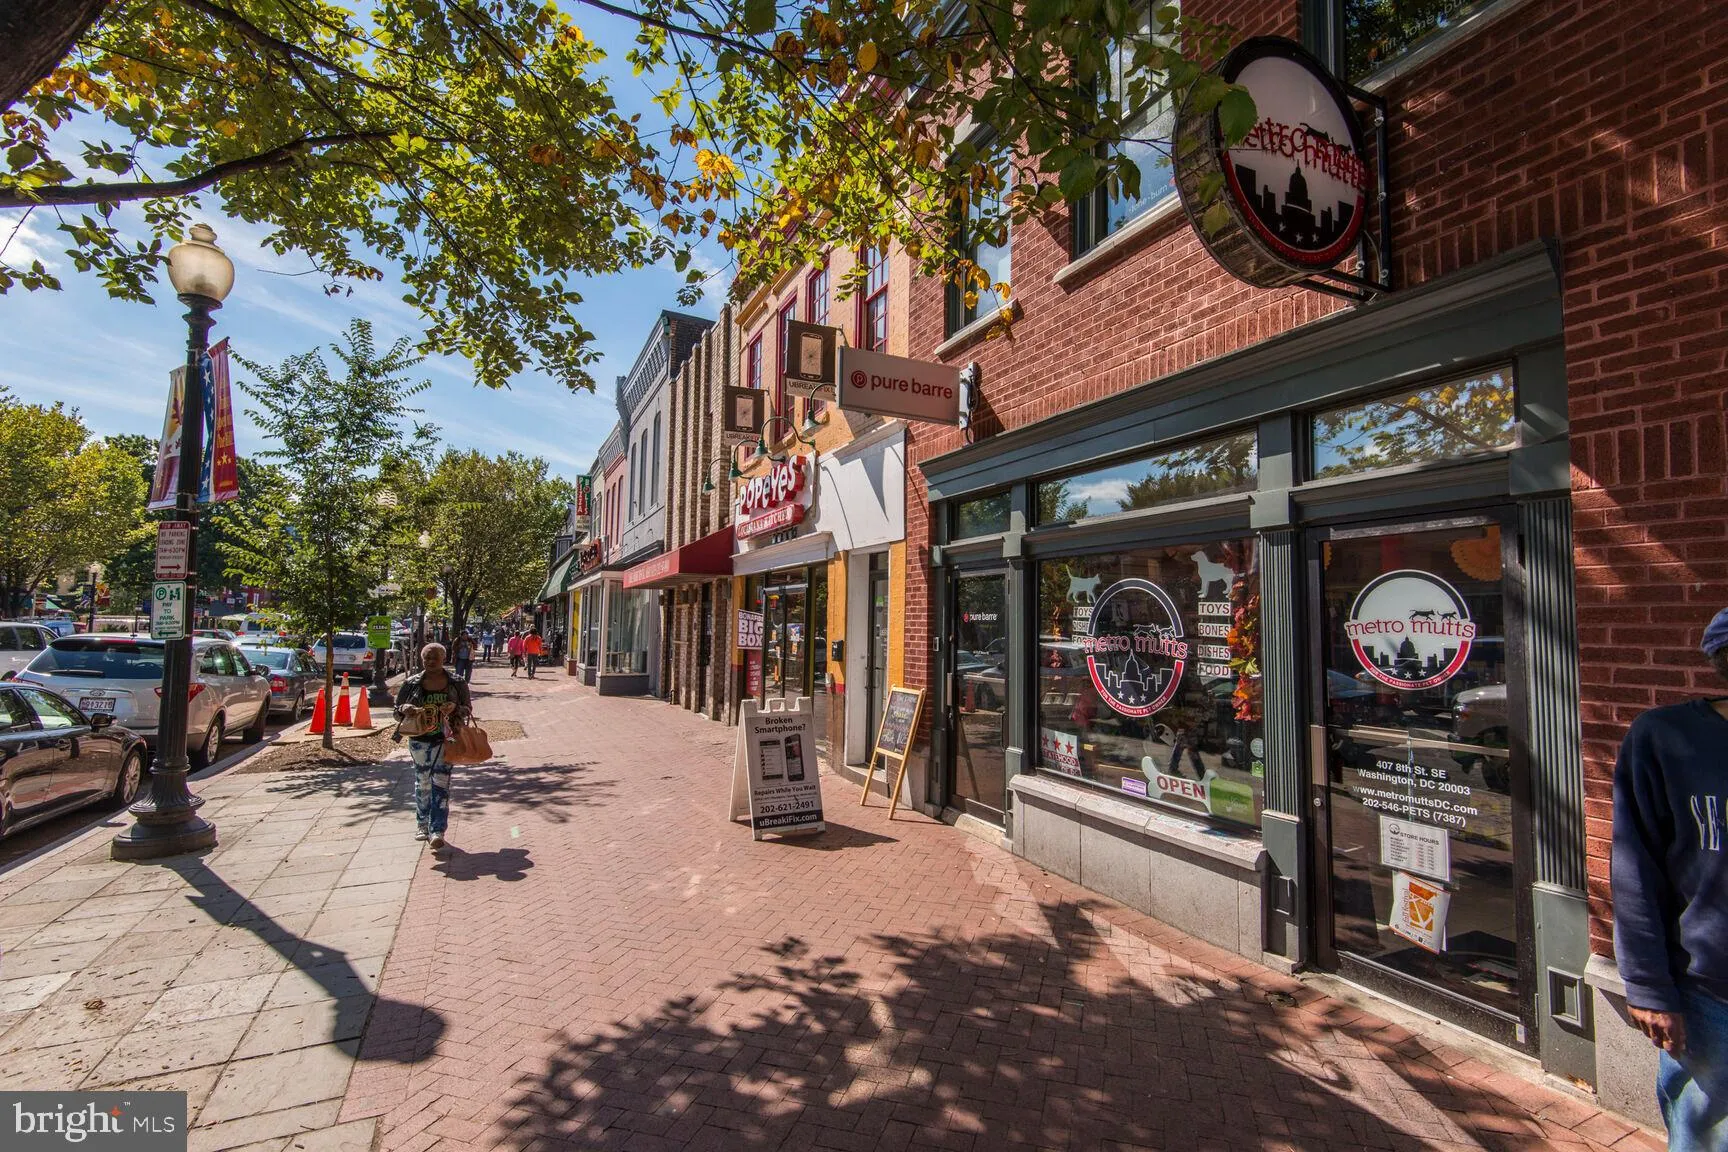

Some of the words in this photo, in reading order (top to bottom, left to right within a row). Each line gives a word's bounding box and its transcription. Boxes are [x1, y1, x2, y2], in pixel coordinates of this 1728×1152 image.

[871, 373, 908, 393] pure
[911, 377, 953, 400] barre
[1199, 603, 1230, 614] TOYS
[969, 613, 981, 622] pure
[981, 611, 998, 621] barre
[738, 619, 763, 635] BIG
[1199, 624, 1230, 637] BONES
[1347, 619, 1404, 636] metro
[1410, 620, 1475, 639] mutts
[738, 633, 763, 647] BOX
[1083, 633, 1131, 654] metro
[1133, 633, 1188, 660] mutts
[1198, 646, 1230, 659] DISHES
[1198, 663, 1230, 676] FOOD
[1389, 679, 1421, 689] PASSIONATE
[1116, 703, 1143, 715] PASSIONATE
[765, 717, 793, 725] Broken
[754, 723, 806, 734] Smartphone?
[1376, 760, 1393, 771] 407
[1395, 763, 1412, 774] 8th
[1414, 765, 1428, 776] St.
[1430, 768, 1447, 779] SE
[1156, 775, 1207, 800] OPEN
[1357, 768, 1417, 788] Washington,
[1419, 778, 1436, 790] DC
[1438, 781, 1471, 796] 20003
[754, 788, 775, 796] Repairs
[791, 785, 803, 793] You
[1352, 785, 1478, 816] www.metromuttsDC.com
[1362, 797, 1431, 819] 202-546-PETS
[1432, 811, 1466, 828] (7387)
[1400, 832, 1418, 841] STORE
[1419, 837, 1440, 846] HOURS
